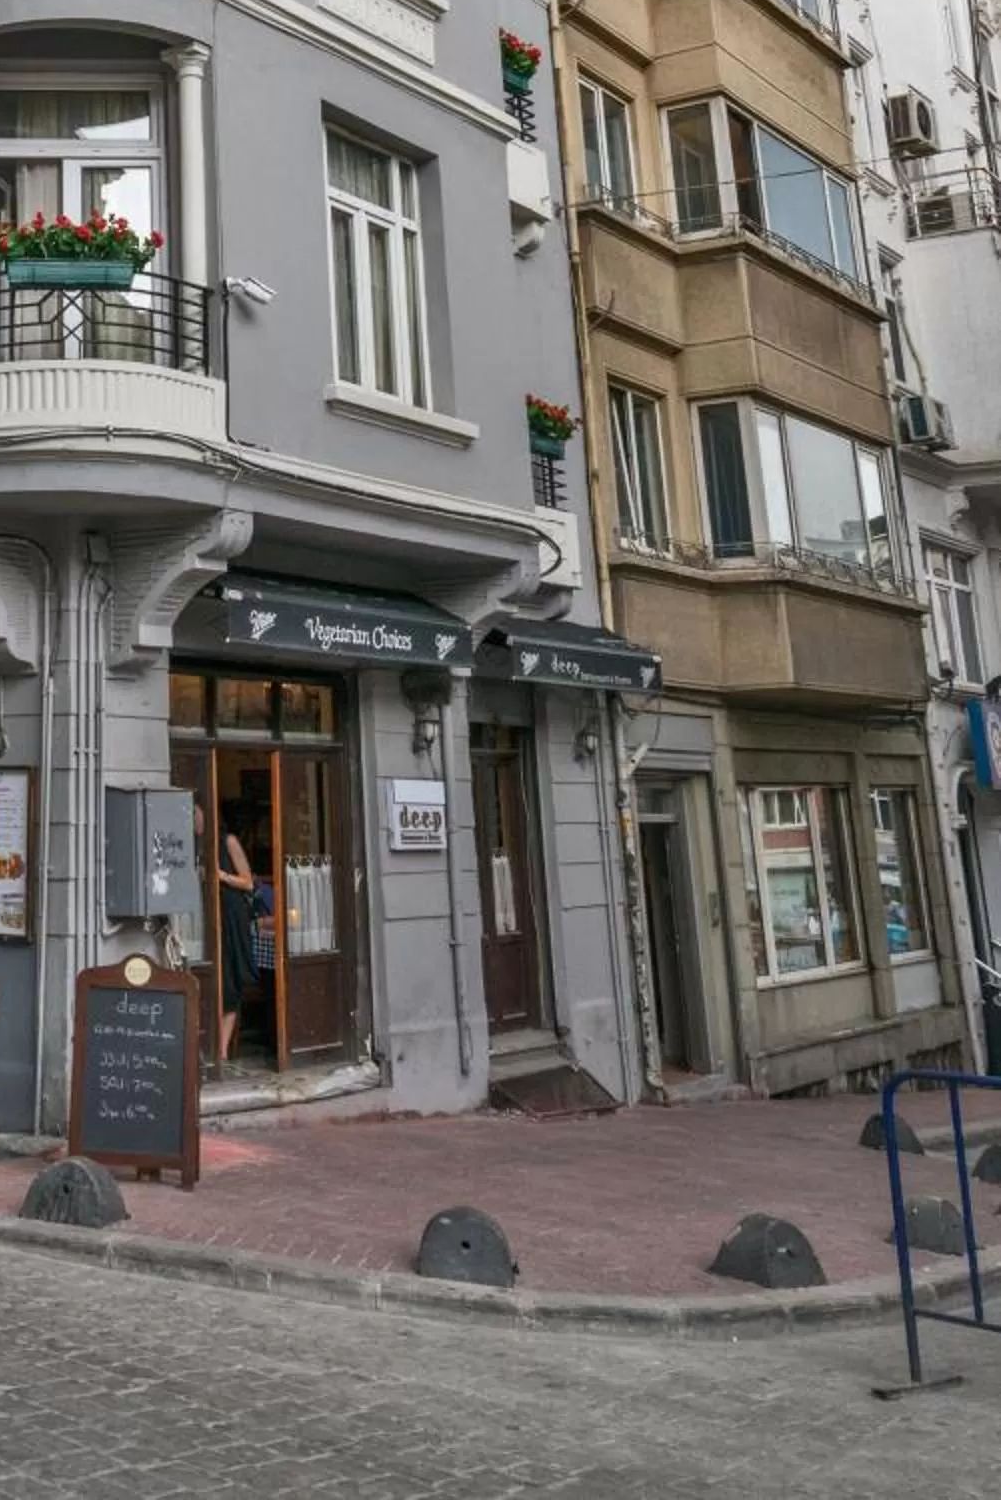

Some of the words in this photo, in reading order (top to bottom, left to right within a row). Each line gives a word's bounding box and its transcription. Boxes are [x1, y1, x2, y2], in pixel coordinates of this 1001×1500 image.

[304, 615, 370, 651] Vegetarian
[372, 624, 412, 651] Choices
[116, 991, 164, 1026] deep
